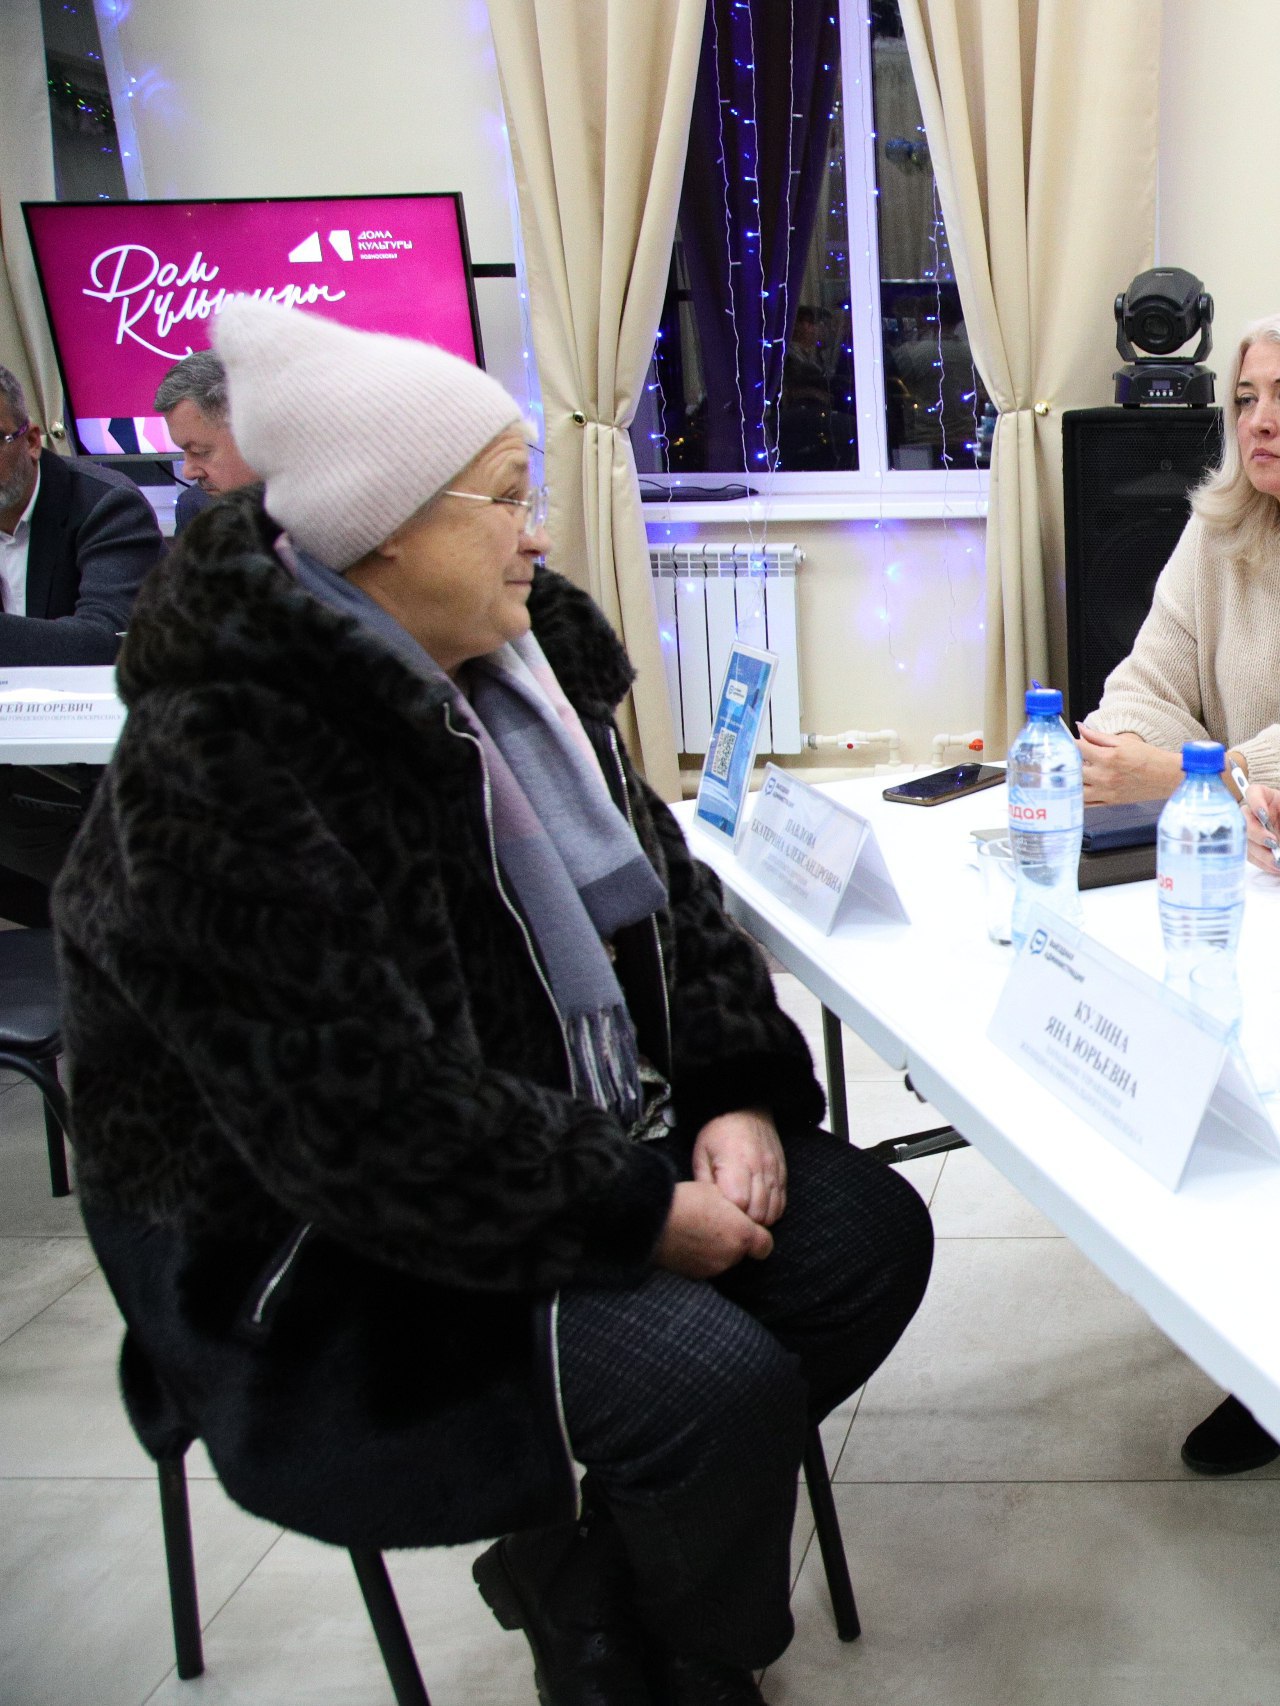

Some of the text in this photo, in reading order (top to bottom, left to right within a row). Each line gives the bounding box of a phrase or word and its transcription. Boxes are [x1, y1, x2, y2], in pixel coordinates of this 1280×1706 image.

[358, 230, 393, 240] ДОМА
[358, 240, 413, 251] КУЛЬТУРЫ
[82, 243, 219, 303] Дом
[27, 703, 93, 713] ИГОРЕВИЧ
[1074, 1000, 1129, 1054] КУЛИНА
[1045, 1015, 1073, 1049] ЯНА
[1072, 1036, 1138, 1099] ЮРЬЕВНА
